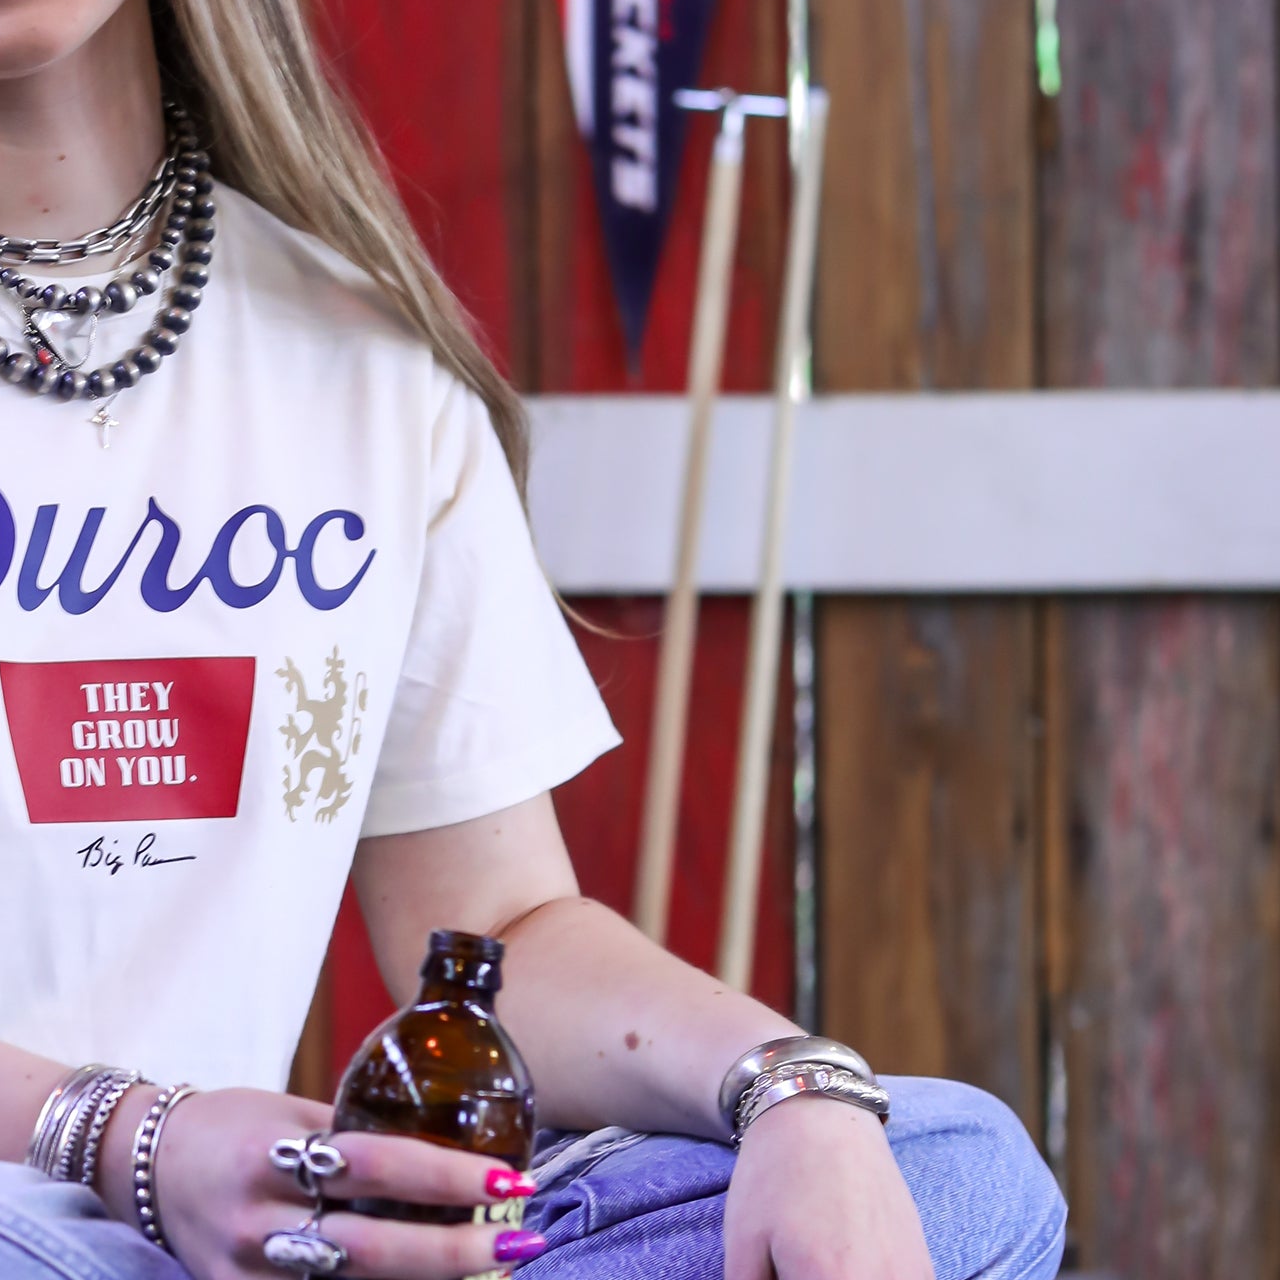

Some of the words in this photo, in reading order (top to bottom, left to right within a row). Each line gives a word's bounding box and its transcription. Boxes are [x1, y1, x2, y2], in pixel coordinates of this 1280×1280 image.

[80, 681, 174, 712] THEY
[72, 718, 179, 750] GROW
[60, 757, 106, 787] ON
[116, 755, 198, 786] YOU.
